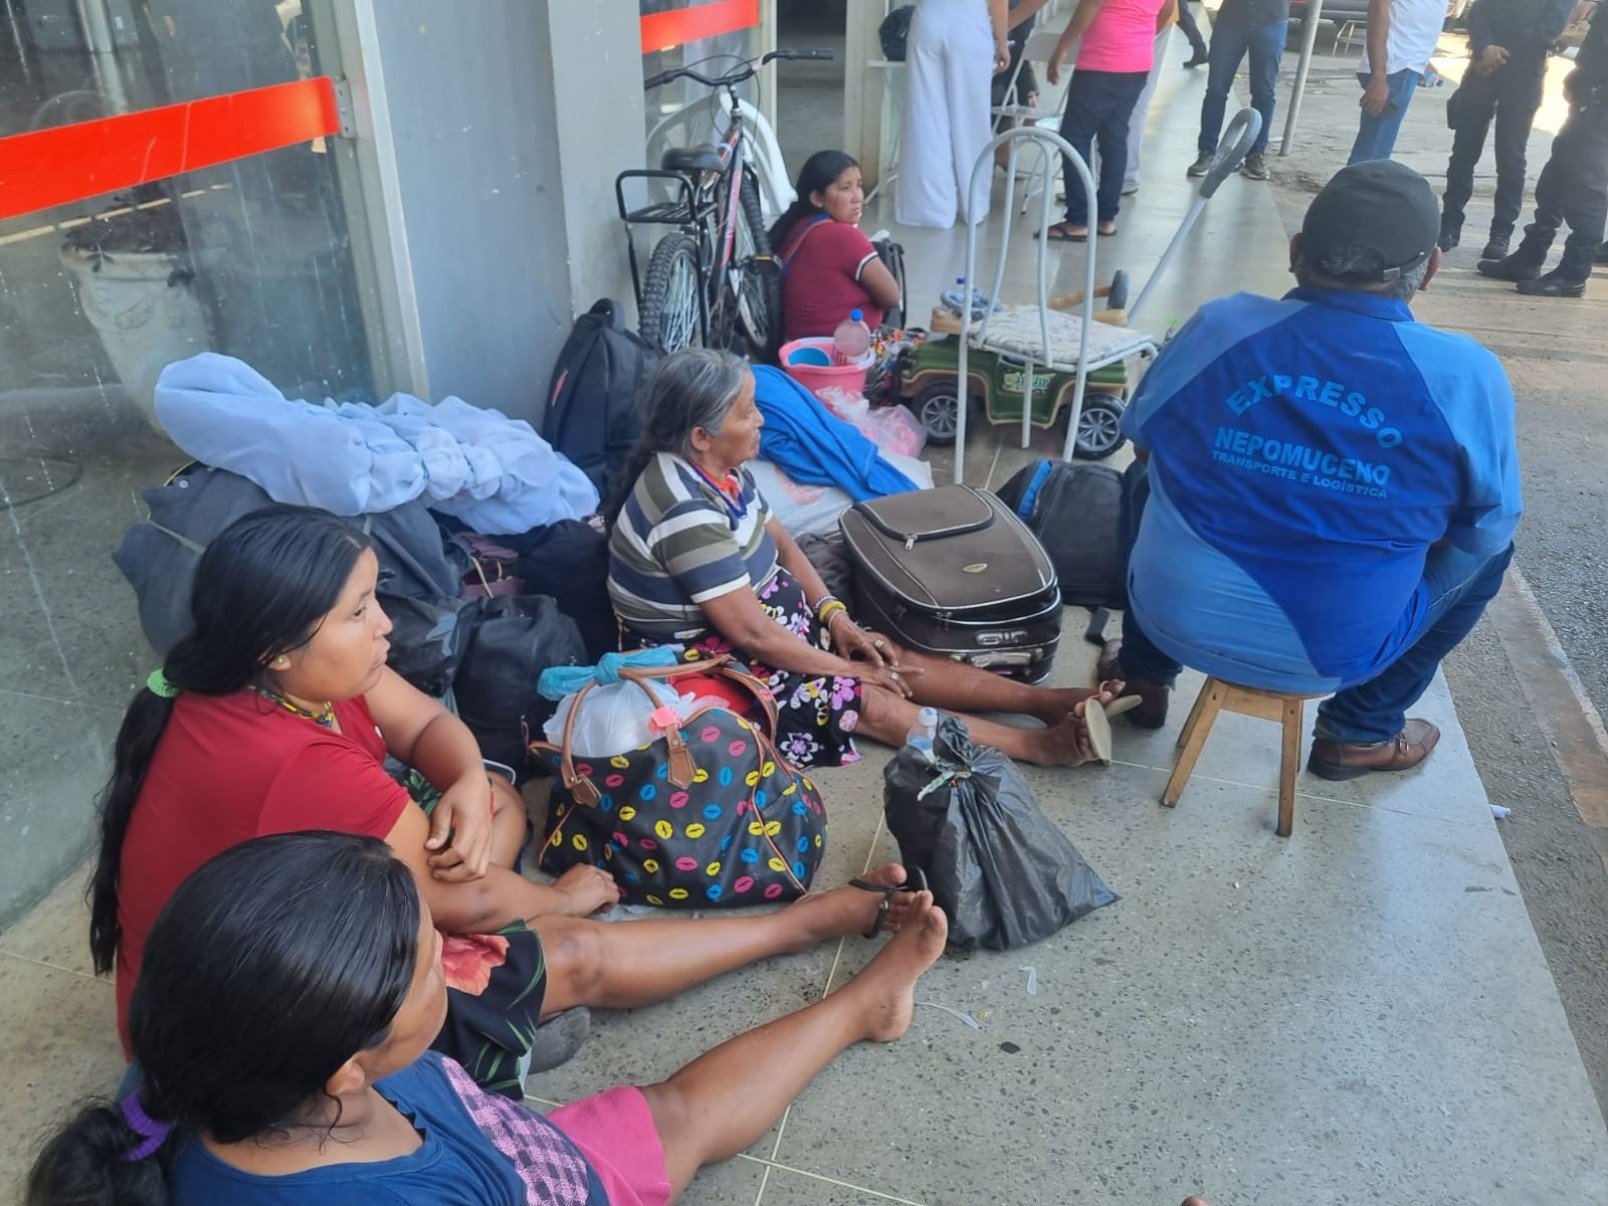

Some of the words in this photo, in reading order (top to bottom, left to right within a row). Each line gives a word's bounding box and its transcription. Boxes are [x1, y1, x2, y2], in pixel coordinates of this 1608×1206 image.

[1226, 374, 1402, 448] EXPRESSO
[1211, 450, 1298, 480] TRANSPORTE
[1301, 472, 1311, 483] E
[1214, 426, 1390, 485] NEPOMUCENO
